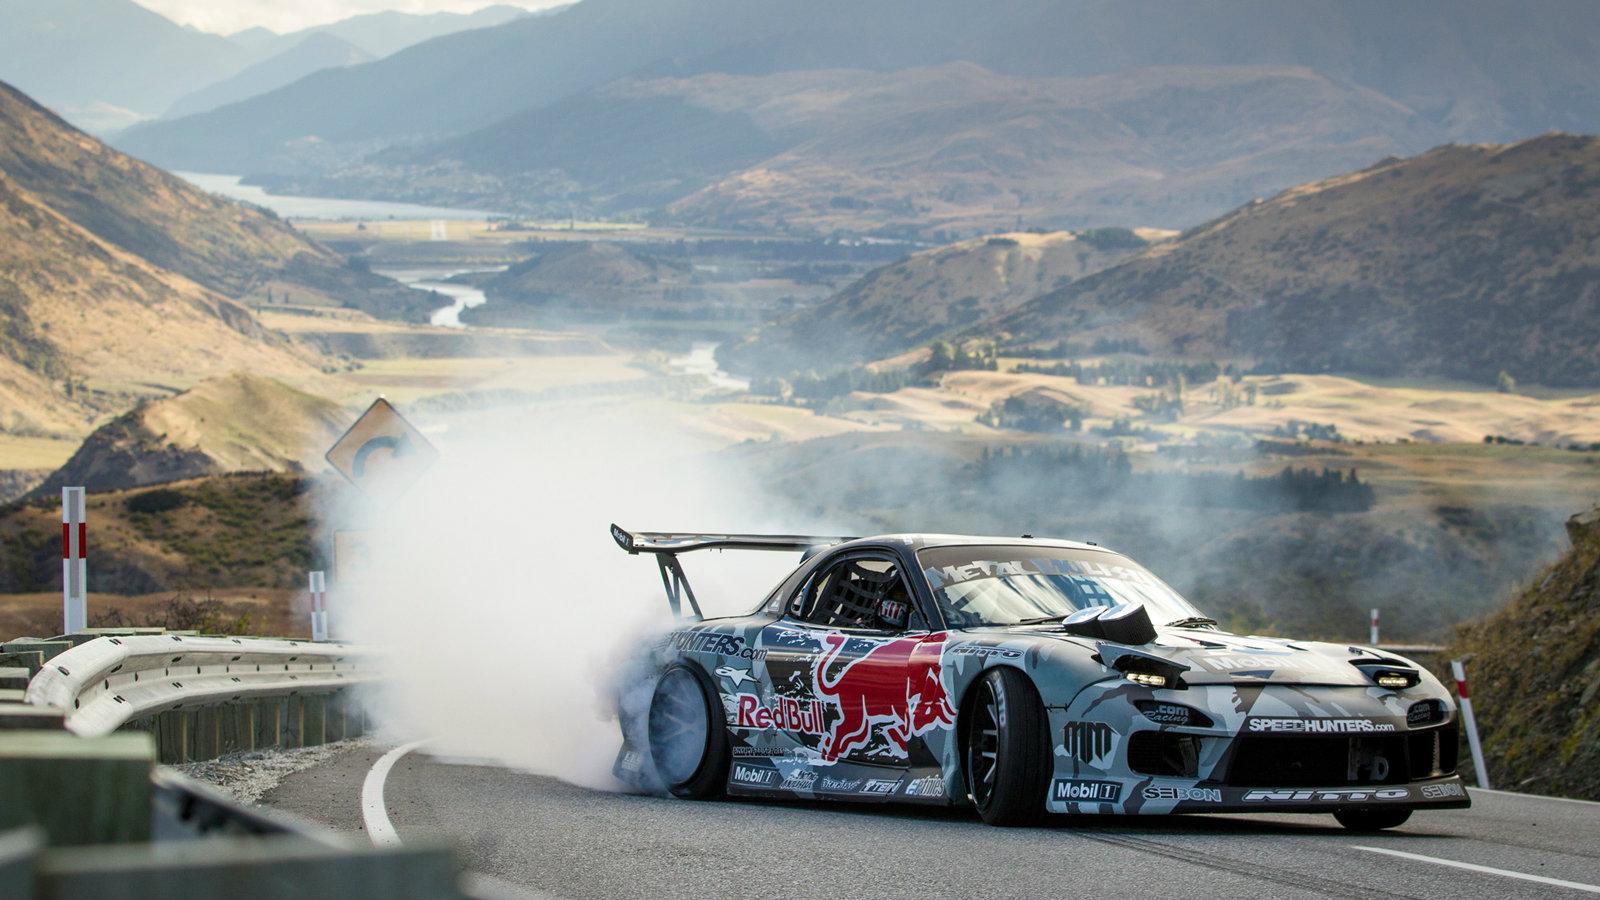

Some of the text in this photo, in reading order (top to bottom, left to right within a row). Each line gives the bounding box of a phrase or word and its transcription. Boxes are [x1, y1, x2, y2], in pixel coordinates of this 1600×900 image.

[924, 559, 1148, 588] METAL MULIS
[1249, 718, 1395, 732] SPEEDHUNTERS.com
[734, 766, 764, 783] Mobil
[1057, 782, 1099, 798] Mobil
[1143, 787, 1222, 802] SEIBON
[1242, 787, 1410, 801] NITTO
